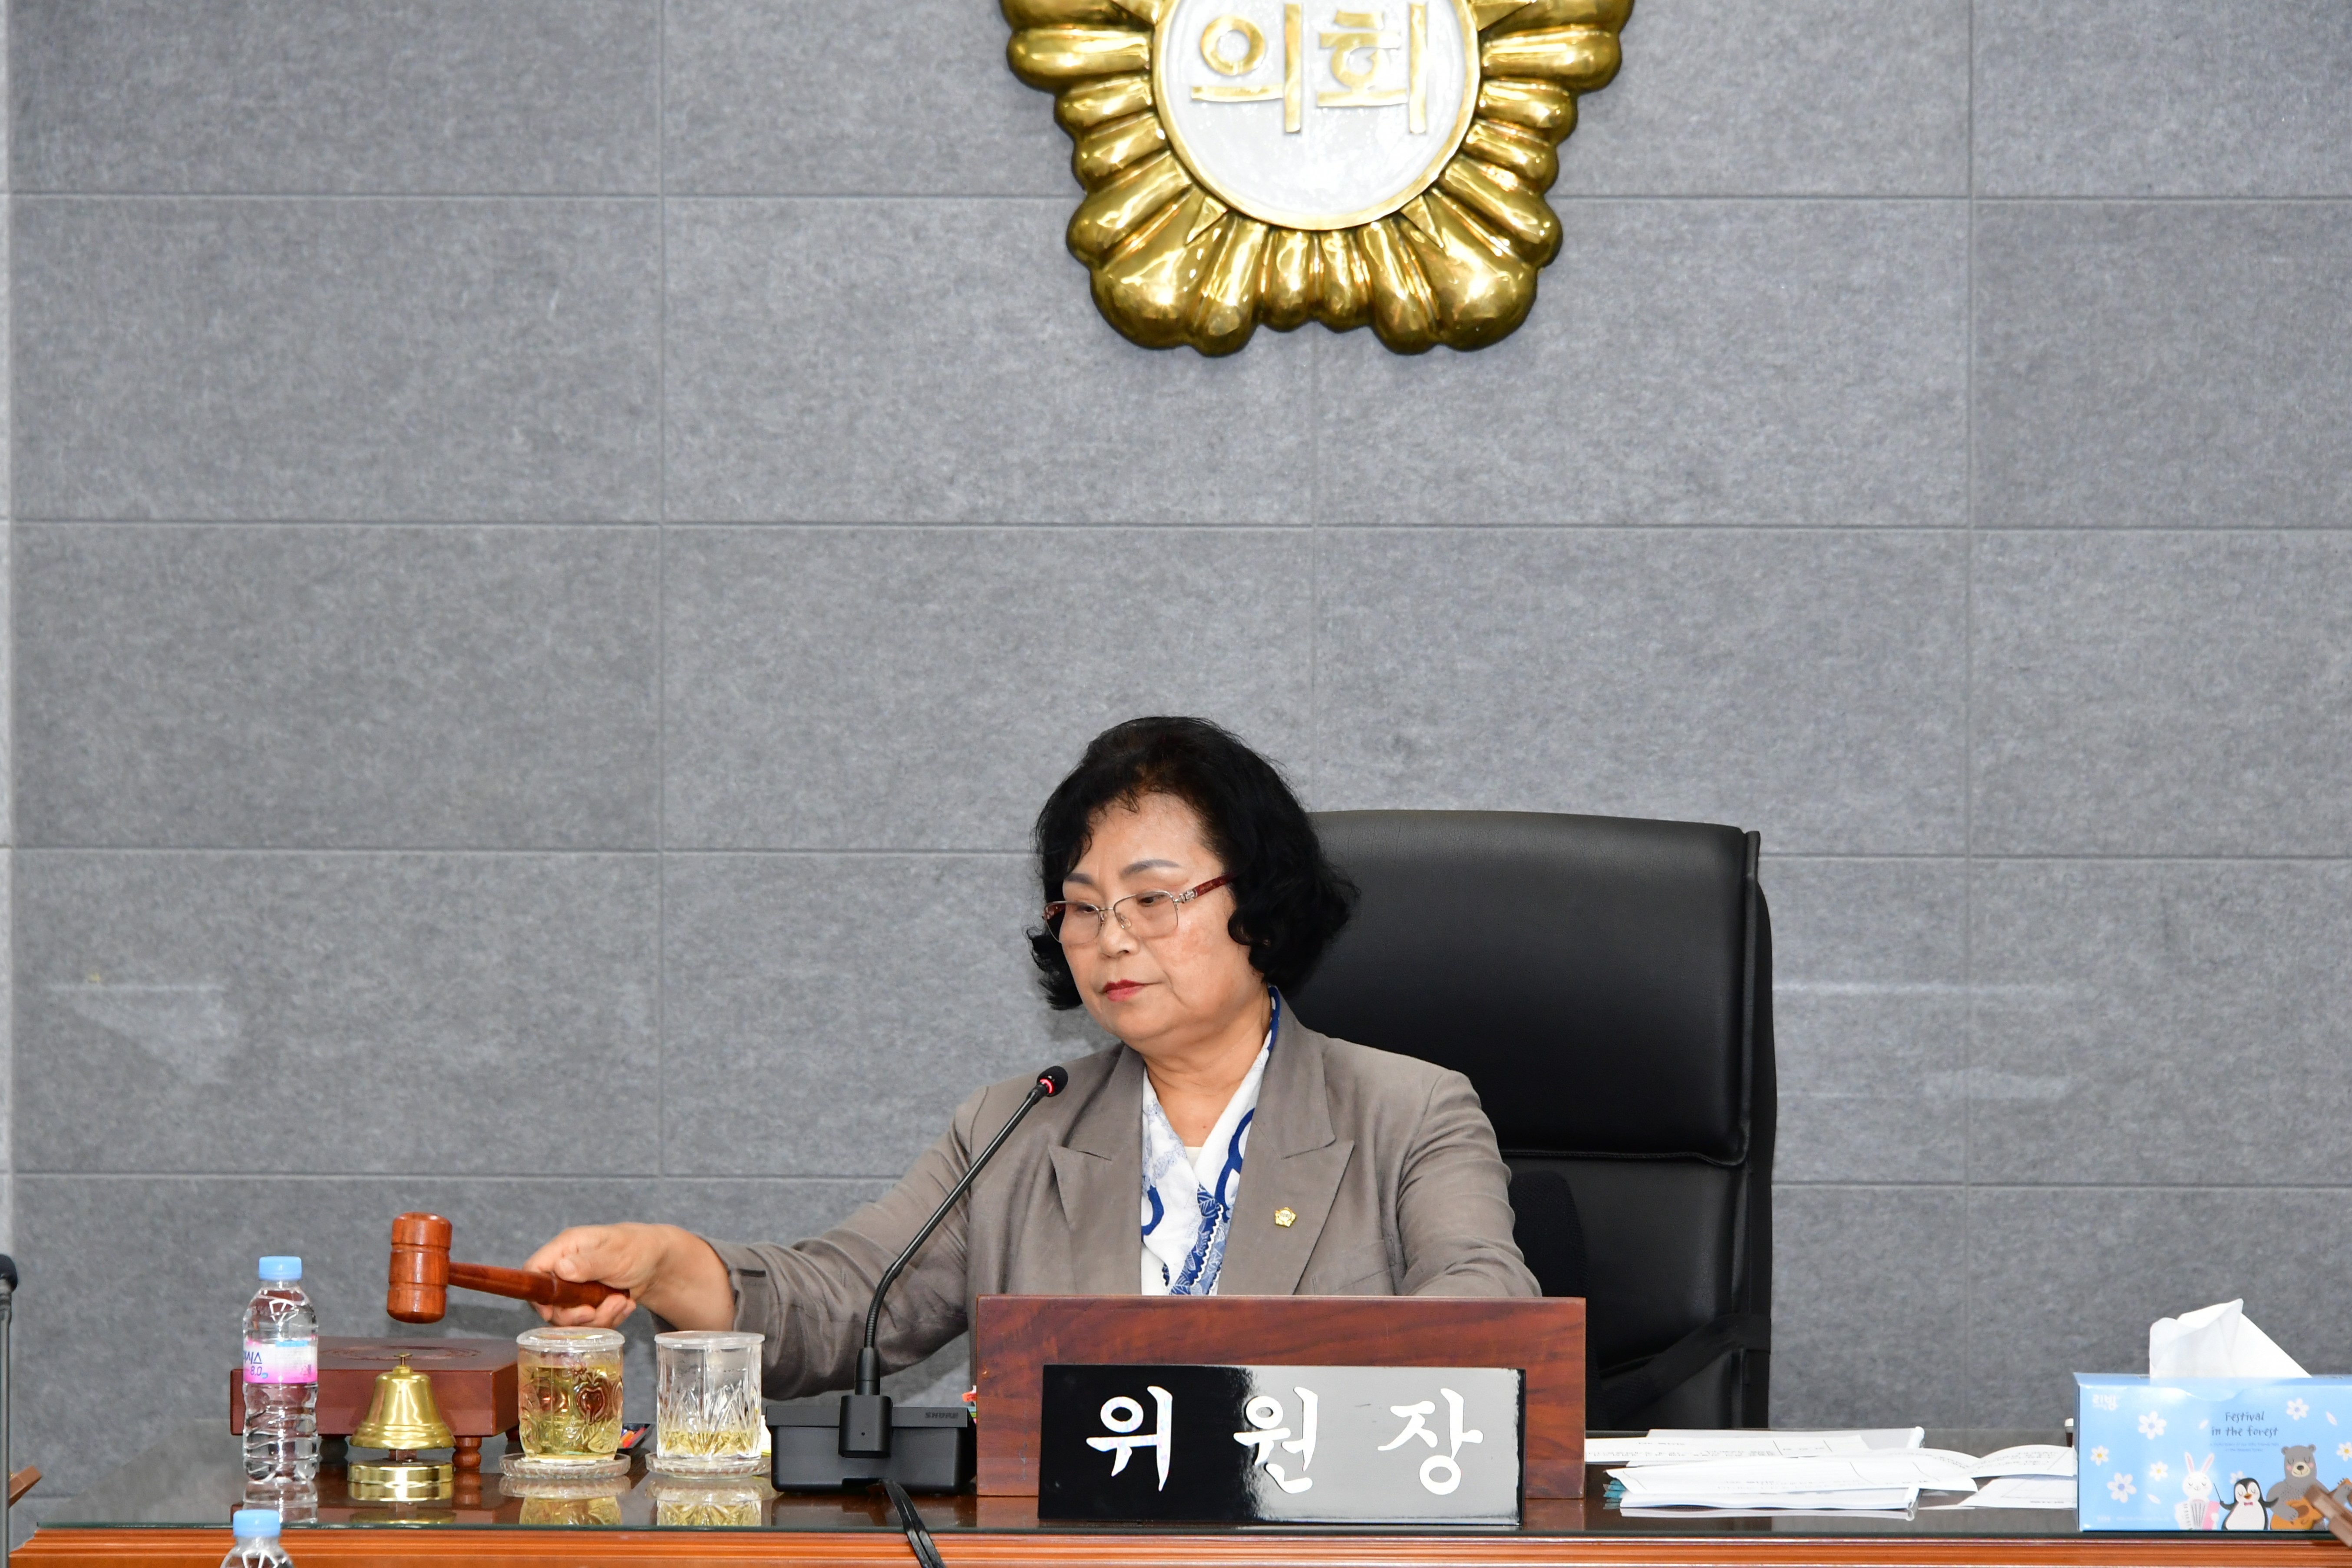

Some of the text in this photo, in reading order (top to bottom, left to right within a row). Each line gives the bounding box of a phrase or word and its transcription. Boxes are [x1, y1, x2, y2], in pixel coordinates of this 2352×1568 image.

[1191, 4, 1427, 133] 의회
[250, 1366, 262, 1376] 8.0
[2225, 1411, 2264, 1423] Festival
[2212, 1425, 2278, 1438] in the forest
